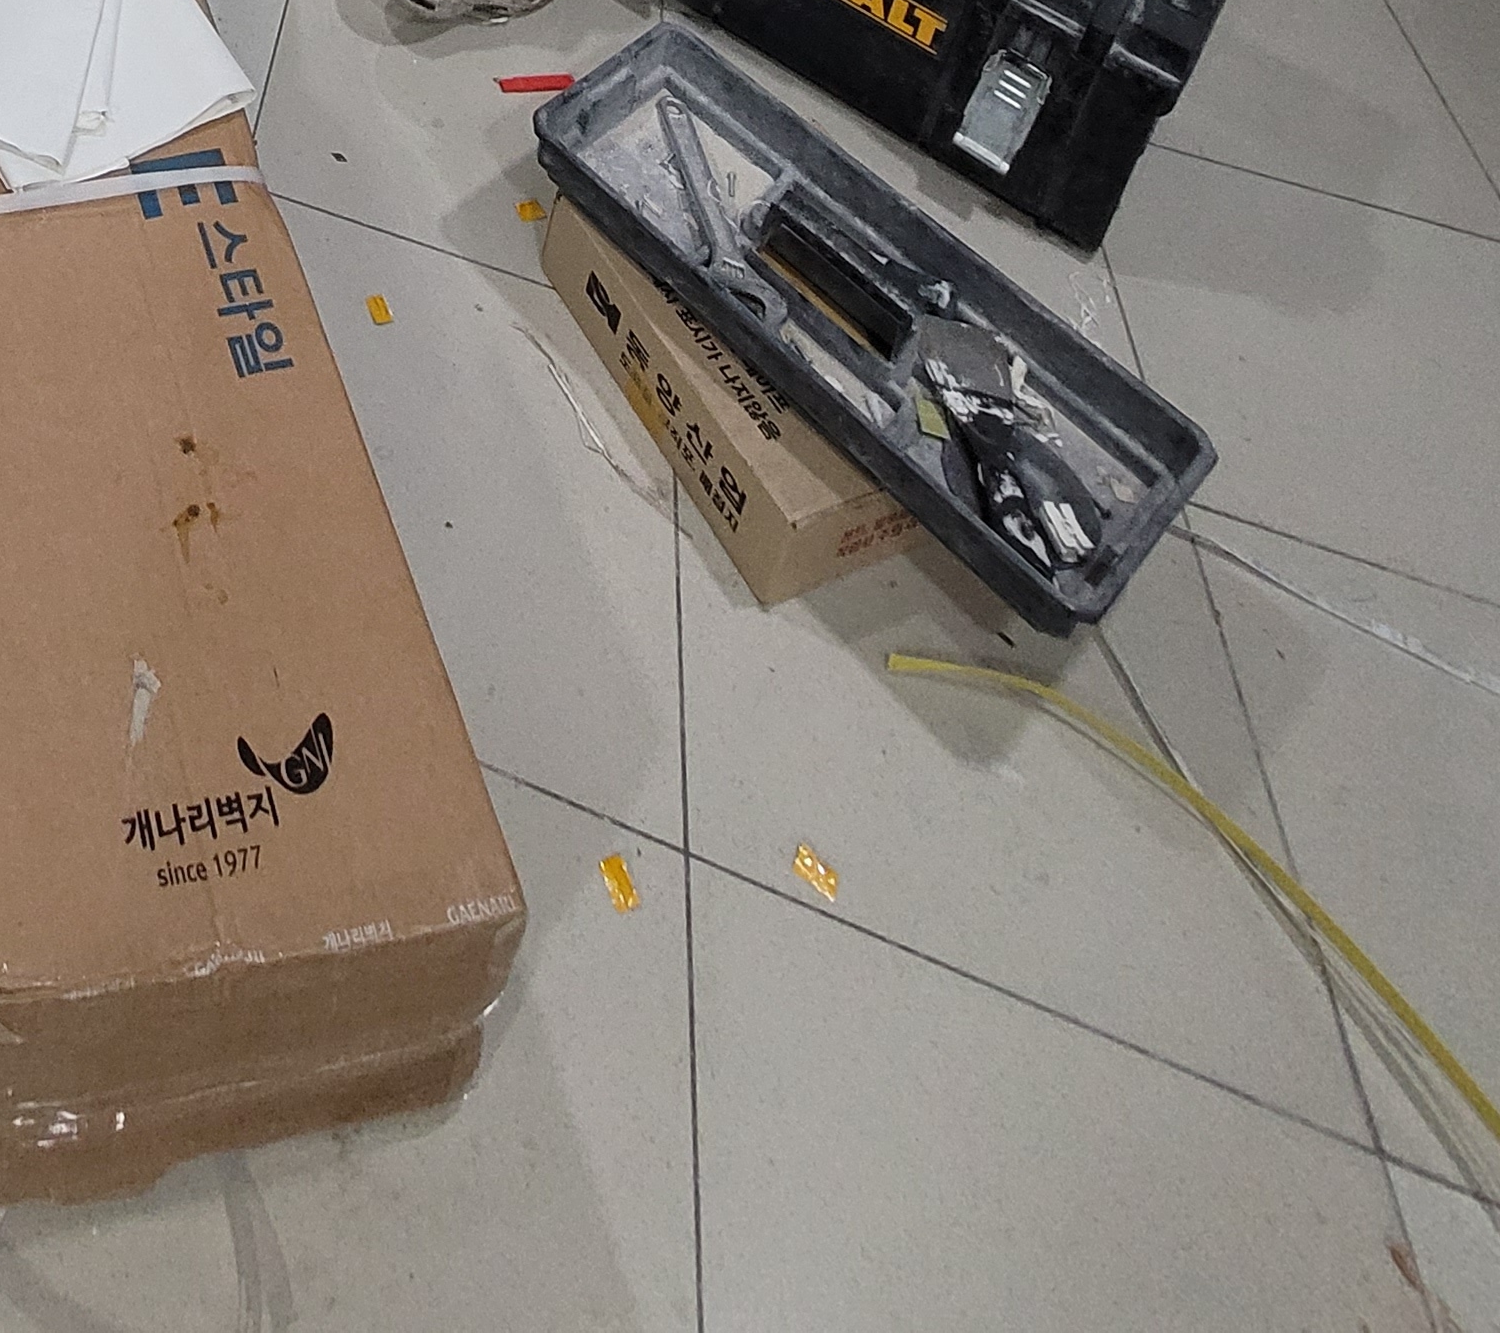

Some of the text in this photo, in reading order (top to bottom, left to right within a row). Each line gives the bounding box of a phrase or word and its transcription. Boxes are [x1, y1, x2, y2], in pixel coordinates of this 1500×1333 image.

[121, 785, 280, 851] 개나리벽지
[156, 844, 262, 887] since 1977
